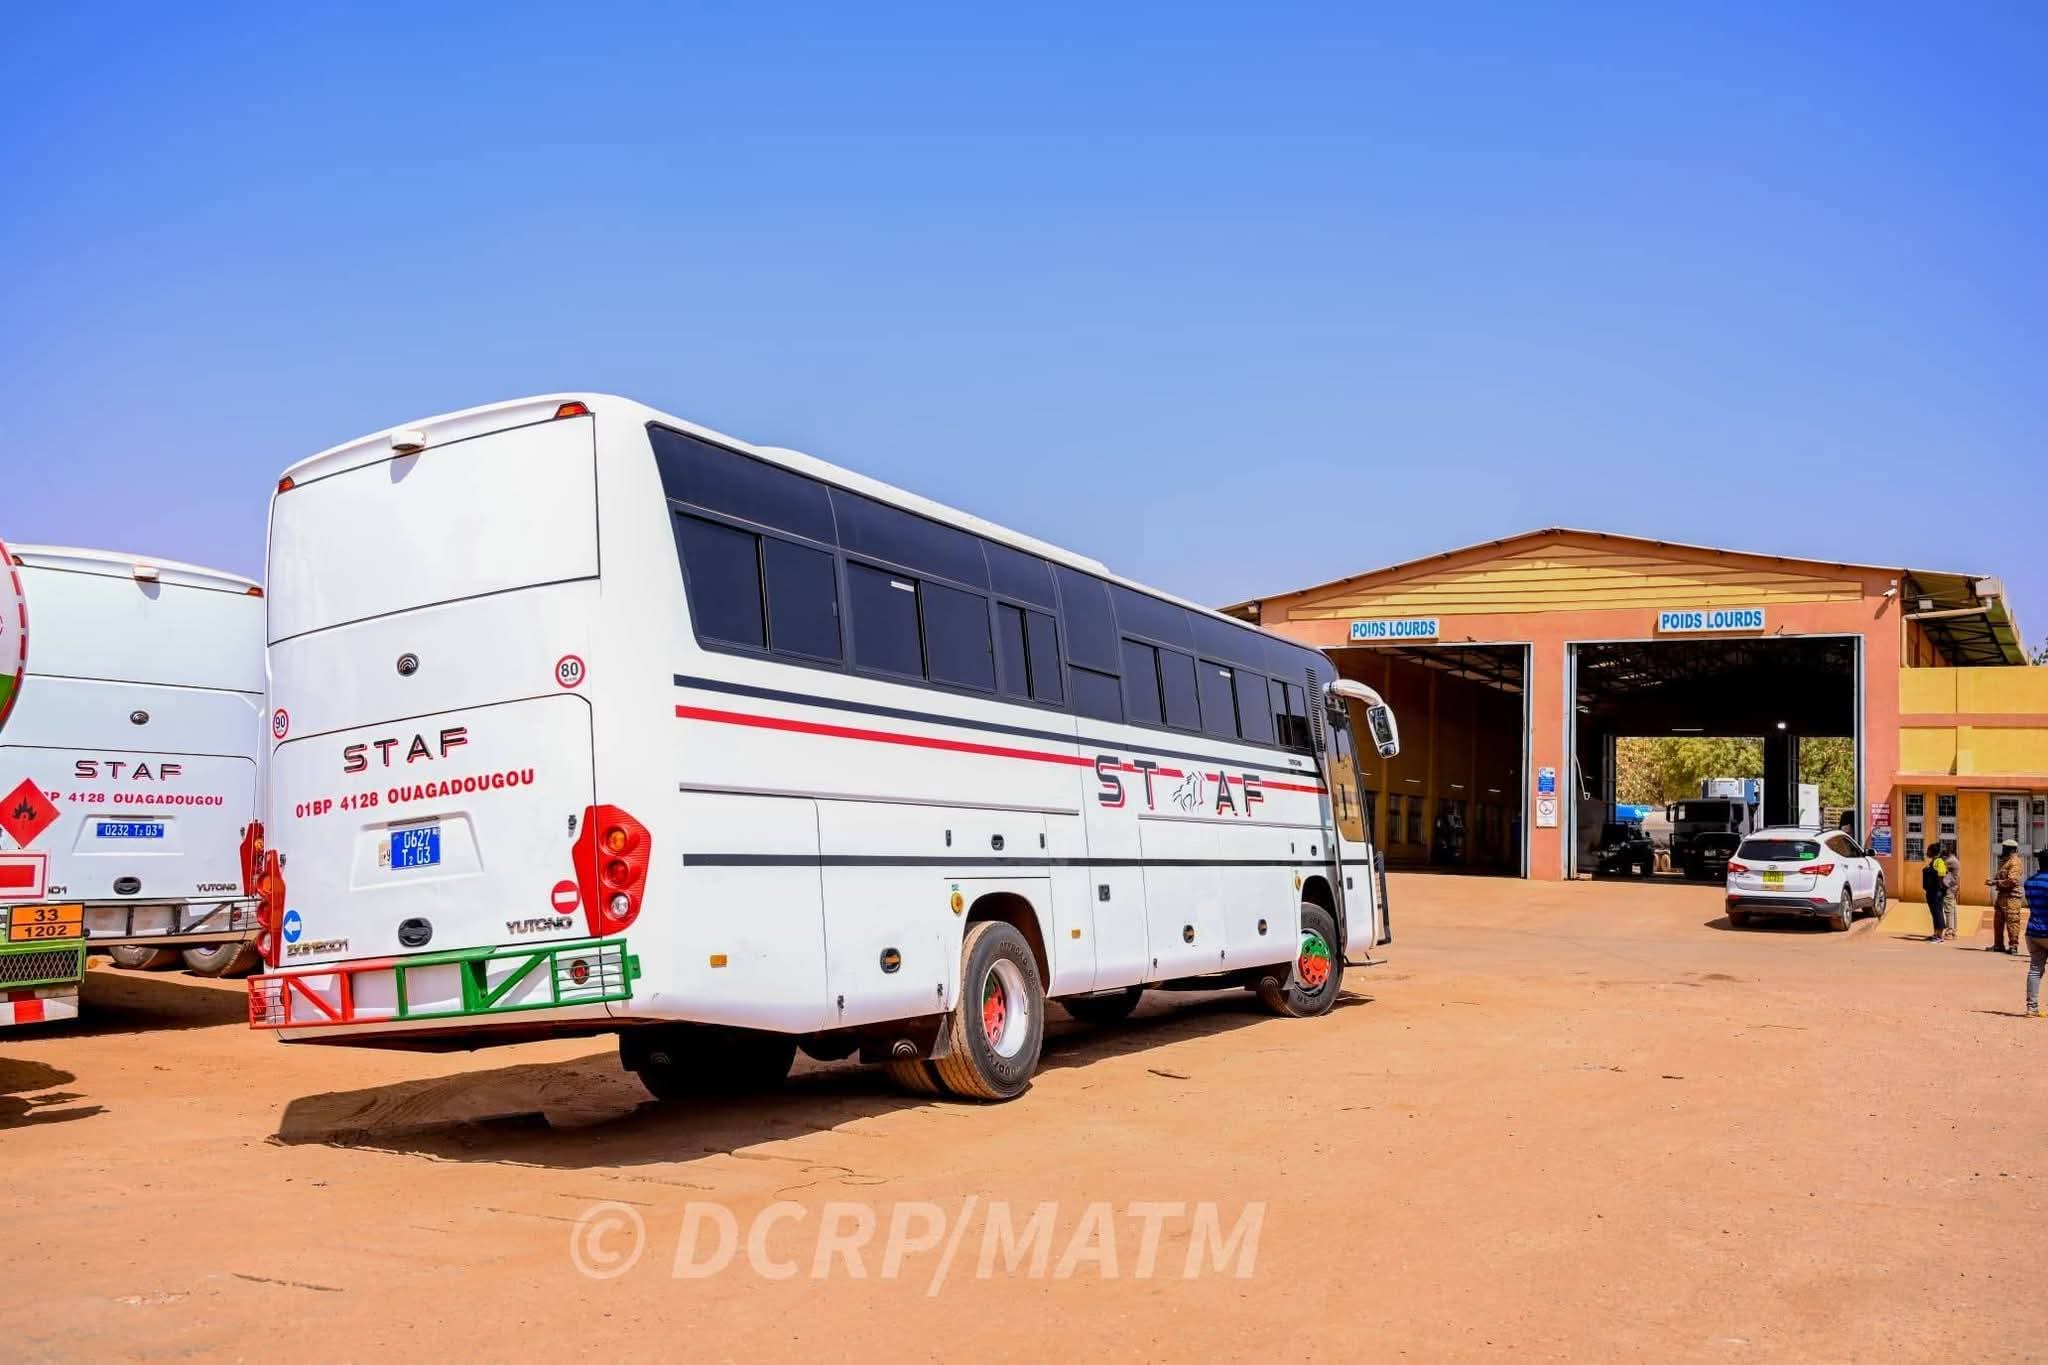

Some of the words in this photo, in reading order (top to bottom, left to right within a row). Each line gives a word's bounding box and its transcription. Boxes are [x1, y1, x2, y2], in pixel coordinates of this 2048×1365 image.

[1352, 622, 1386, 637] POIDS
[1389, 620, 1436, 636] LOURDS
[1662, 613, 1702, 629] POIDS
[1707, 611, 1762, 628] LOURDS
[561, 662, 578, 677] 80
[275, 715, 286, 729] 90
[343, 727, 467, 774] STAF
[75, 760, 182, 781] STAF
[44, 791, 60, 801] P
[68, 792, 105, 802] 4128
[113, 793, 224, 806] OUAGADOUGOU
[296, 799, 333, 819] 01BP
[340, 792, 379, 812] 4128
[388, 768, 535, 804] OUAGADOUGOU
[105, 824, 129, 836] 0232
[403, 828, 431, 849] 0627
[417, 846, 431, 865] 03
[34, 909, 59, 921] 33
[24, 925, 67, 937] 1202
